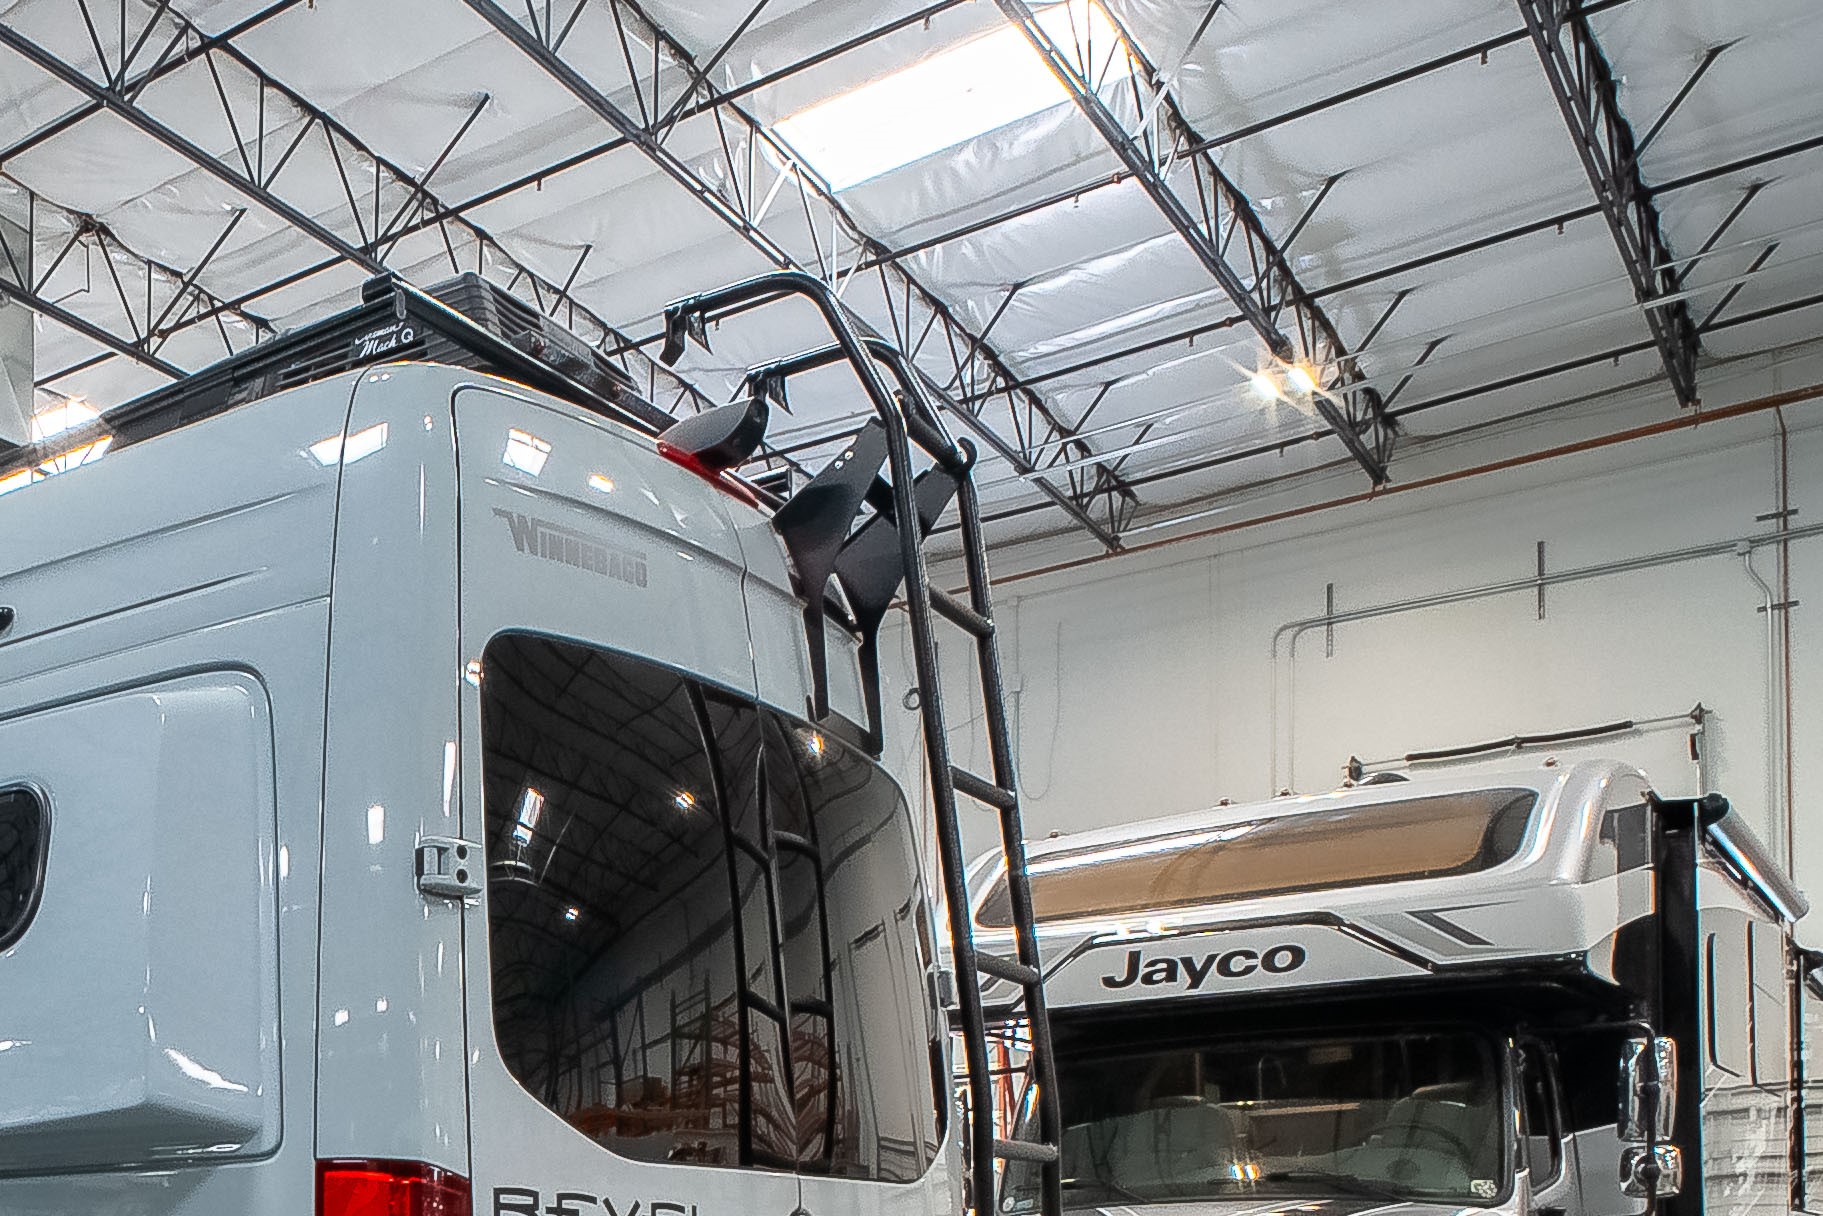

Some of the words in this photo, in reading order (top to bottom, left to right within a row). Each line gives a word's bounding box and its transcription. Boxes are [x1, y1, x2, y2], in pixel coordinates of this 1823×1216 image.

[359, 333, 398, 358] Mach
[401, 327, 414, 343] Q
[492, 506, 648, 589] WINNEBAGO
[1101, 944, 1306, 990] Jayco
